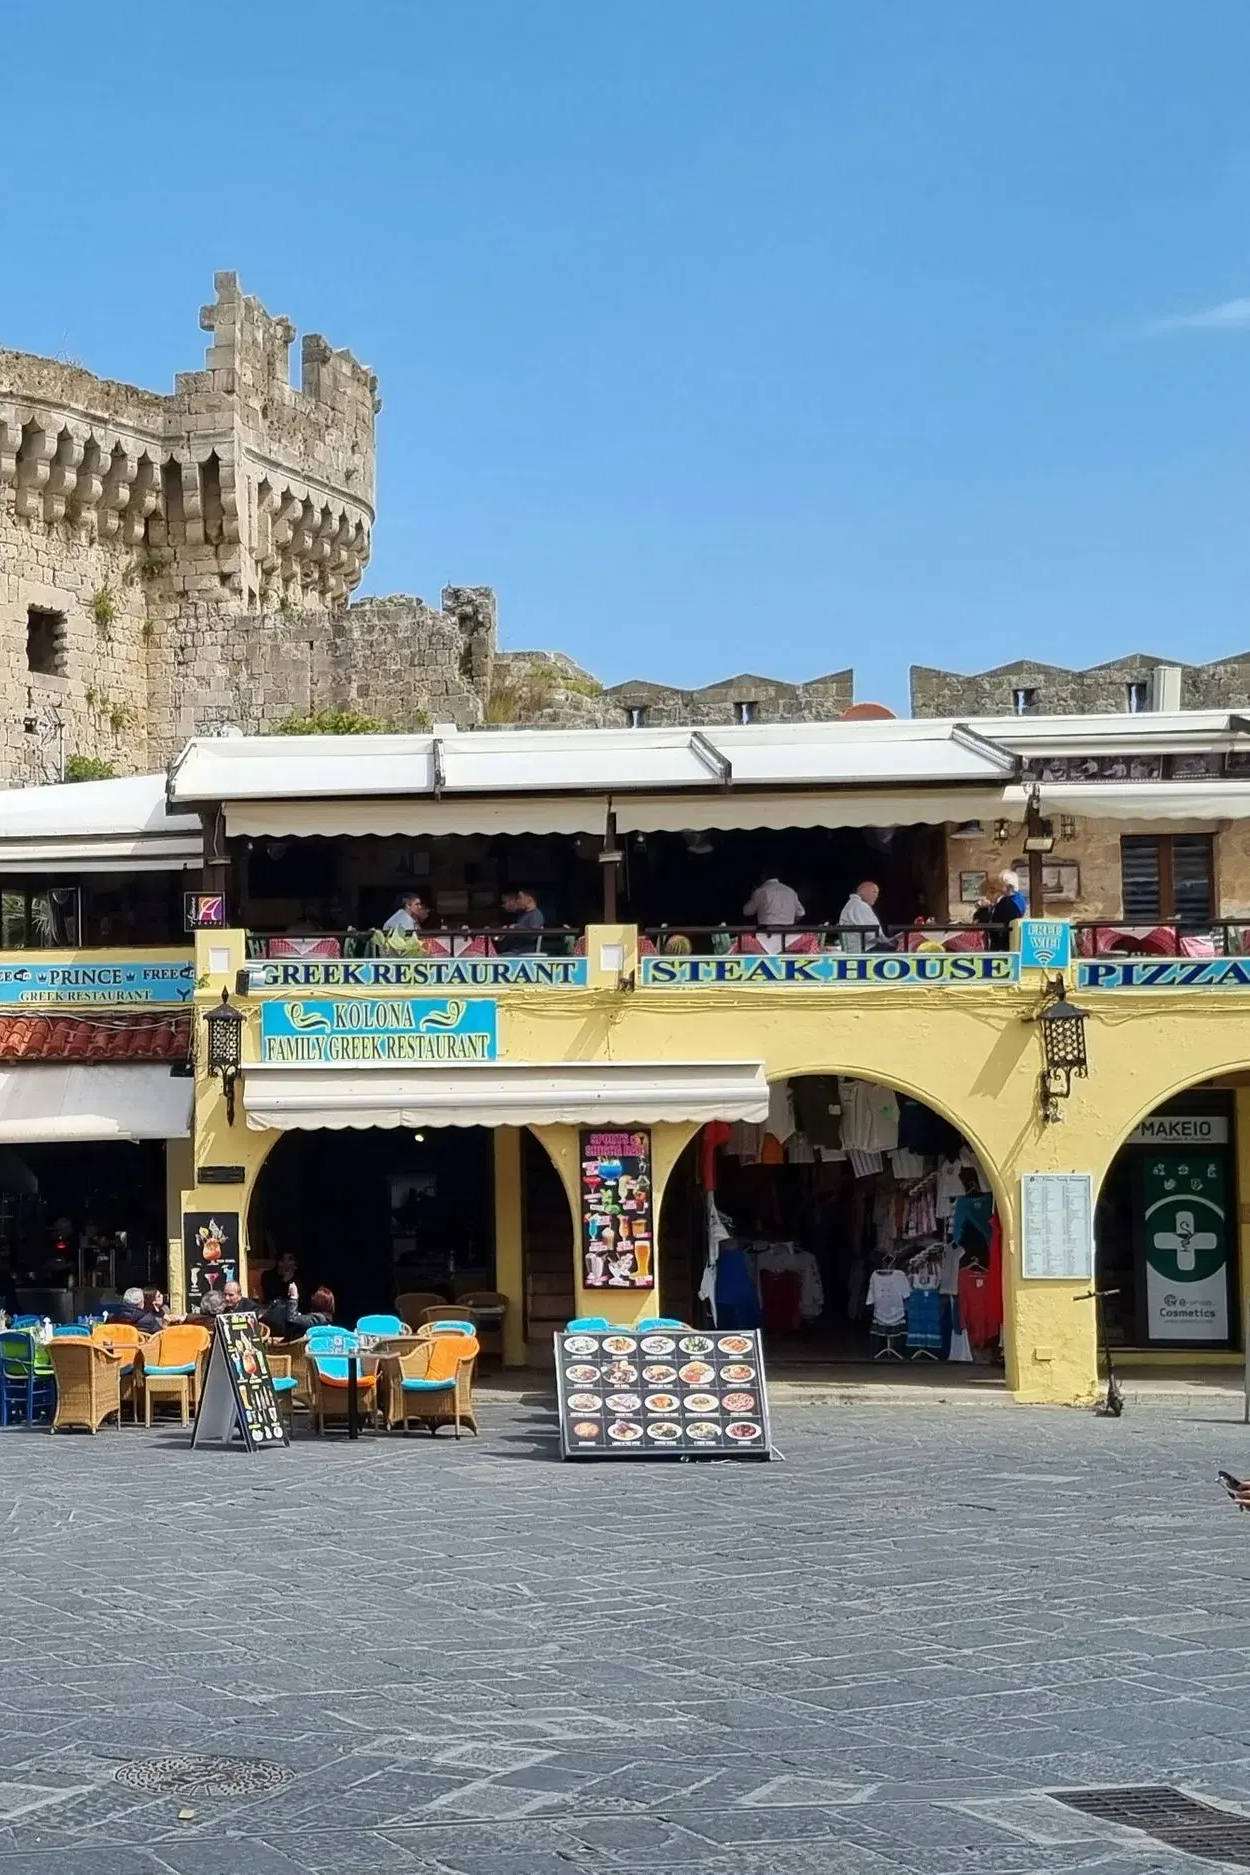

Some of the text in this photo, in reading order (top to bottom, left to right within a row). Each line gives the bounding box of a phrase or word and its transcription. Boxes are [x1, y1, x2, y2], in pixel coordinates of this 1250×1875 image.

[1028, 924, 1062, 936] FREE
[50, 969, 123, 985] PRINCE
[143, 968, 179, 980] FREE
[263, 962, 576, 985] GREEK RESTAURANT
[652, 958, 1011, 982] STEAK HOUSE
[1083, 963, 1250, 987] PIZZA
[20, 990, 151, 1001] GREEK RESTAURANT
[334, 1003, 414, 1029] KOLONA
[267, 1035, 489, 1061] FAMILY GREEK RESTAURANT
[1159, 1307, 1216, 1318] Cosmetics
